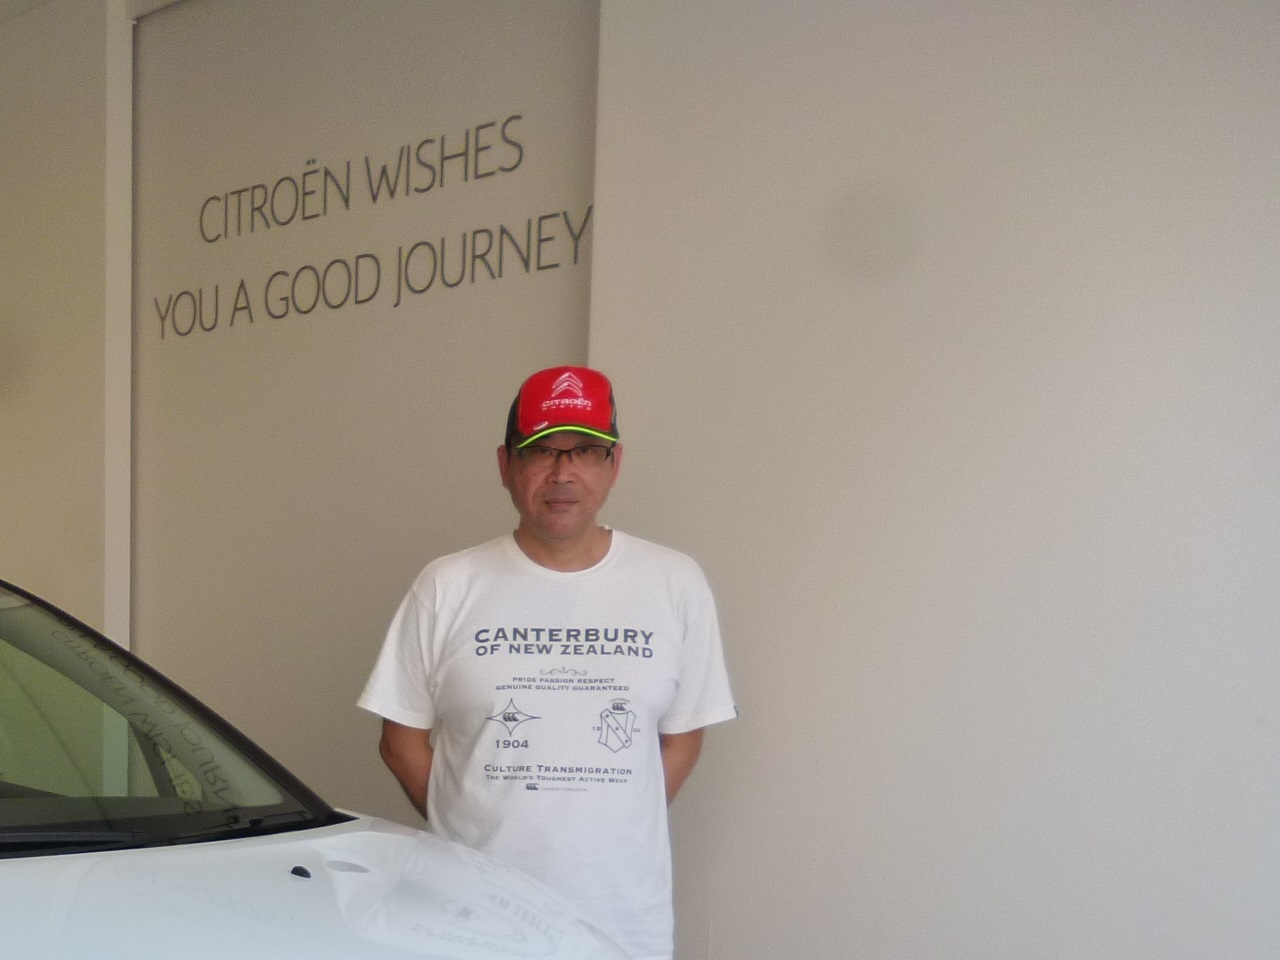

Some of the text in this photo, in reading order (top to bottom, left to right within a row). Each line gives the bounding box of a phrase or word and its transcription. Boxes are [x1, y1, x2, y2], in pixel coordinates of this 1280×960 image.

[199, 115, 524, 243] CITROËN WISHES
[154, 205, 594, 340] YOU A GOOD JOURNEY
[474, 628, 654, 645] CANTERBURY
[475, 643, 654, 659] OF NEW ZEALAND
[495, 739, 529, 749] 1904
